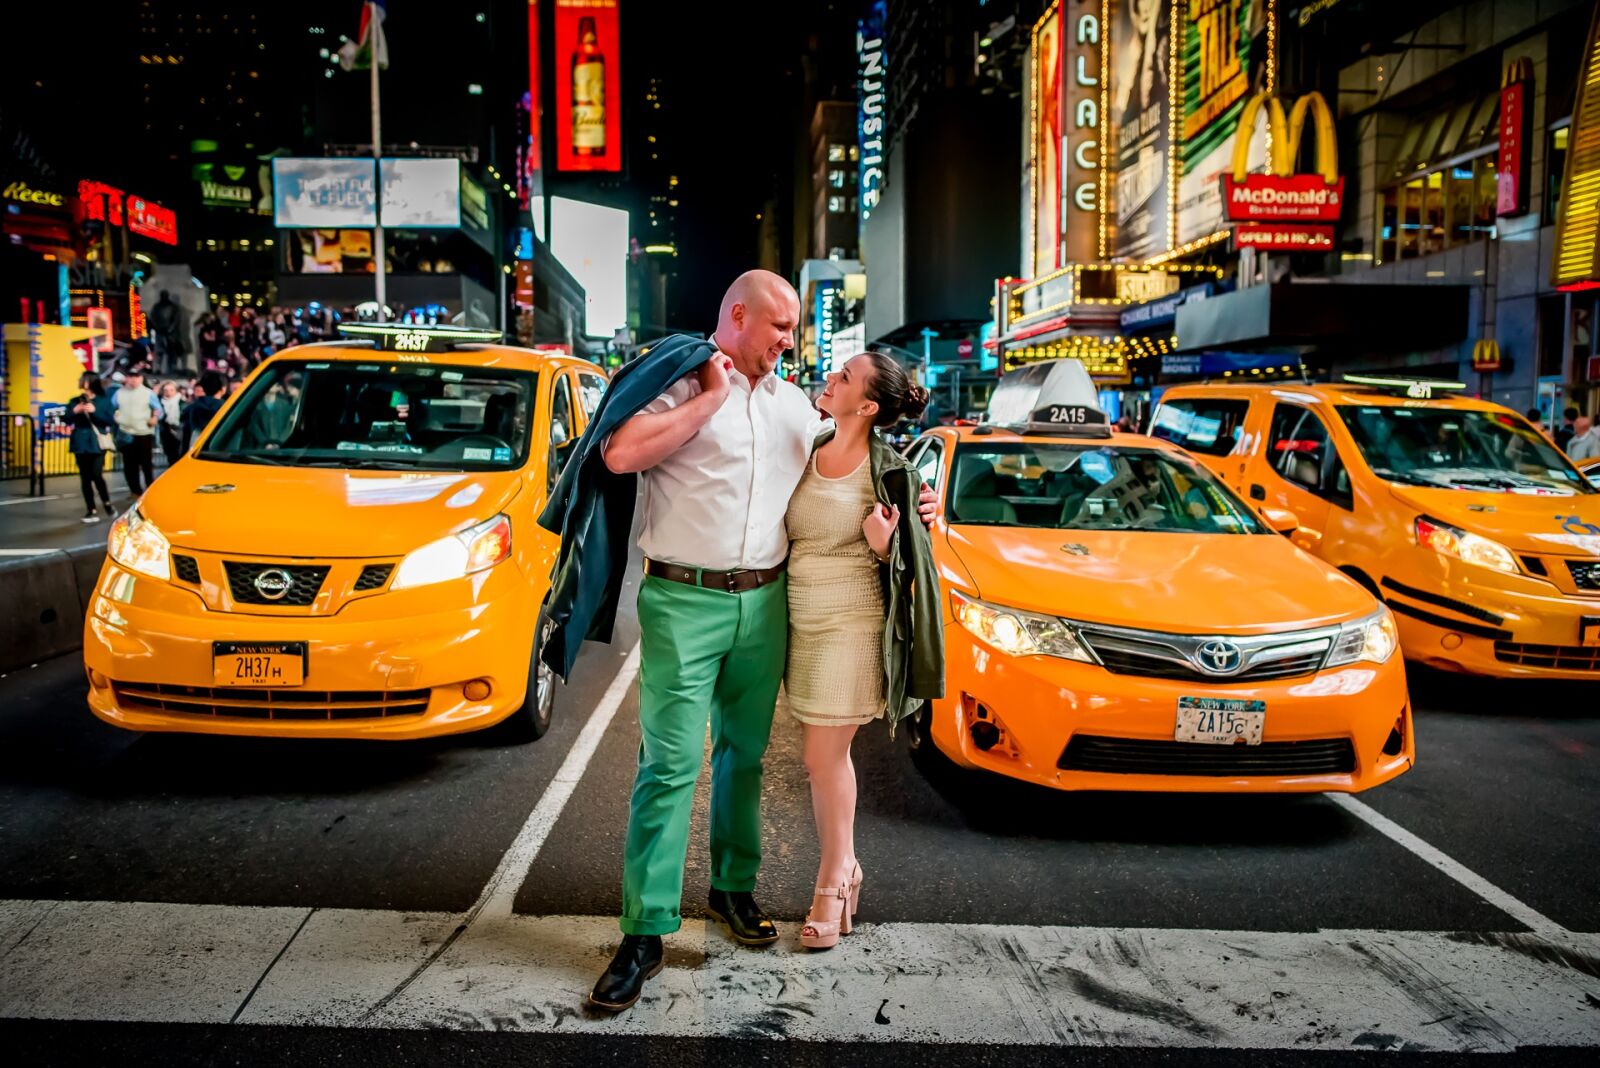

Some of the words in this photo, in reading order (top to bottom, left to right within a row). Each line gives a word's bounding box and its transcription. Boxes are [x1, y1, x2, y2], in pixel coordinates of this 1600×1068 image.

[1232, 187, 1339, 205] McDonald's
[395, 334, 430, 351] 2H37
[1050, 407, 1086, 423] 2A15
[1200, 700, 1220, 710] NEW
[1224, 702, 1245, 711] YORK
